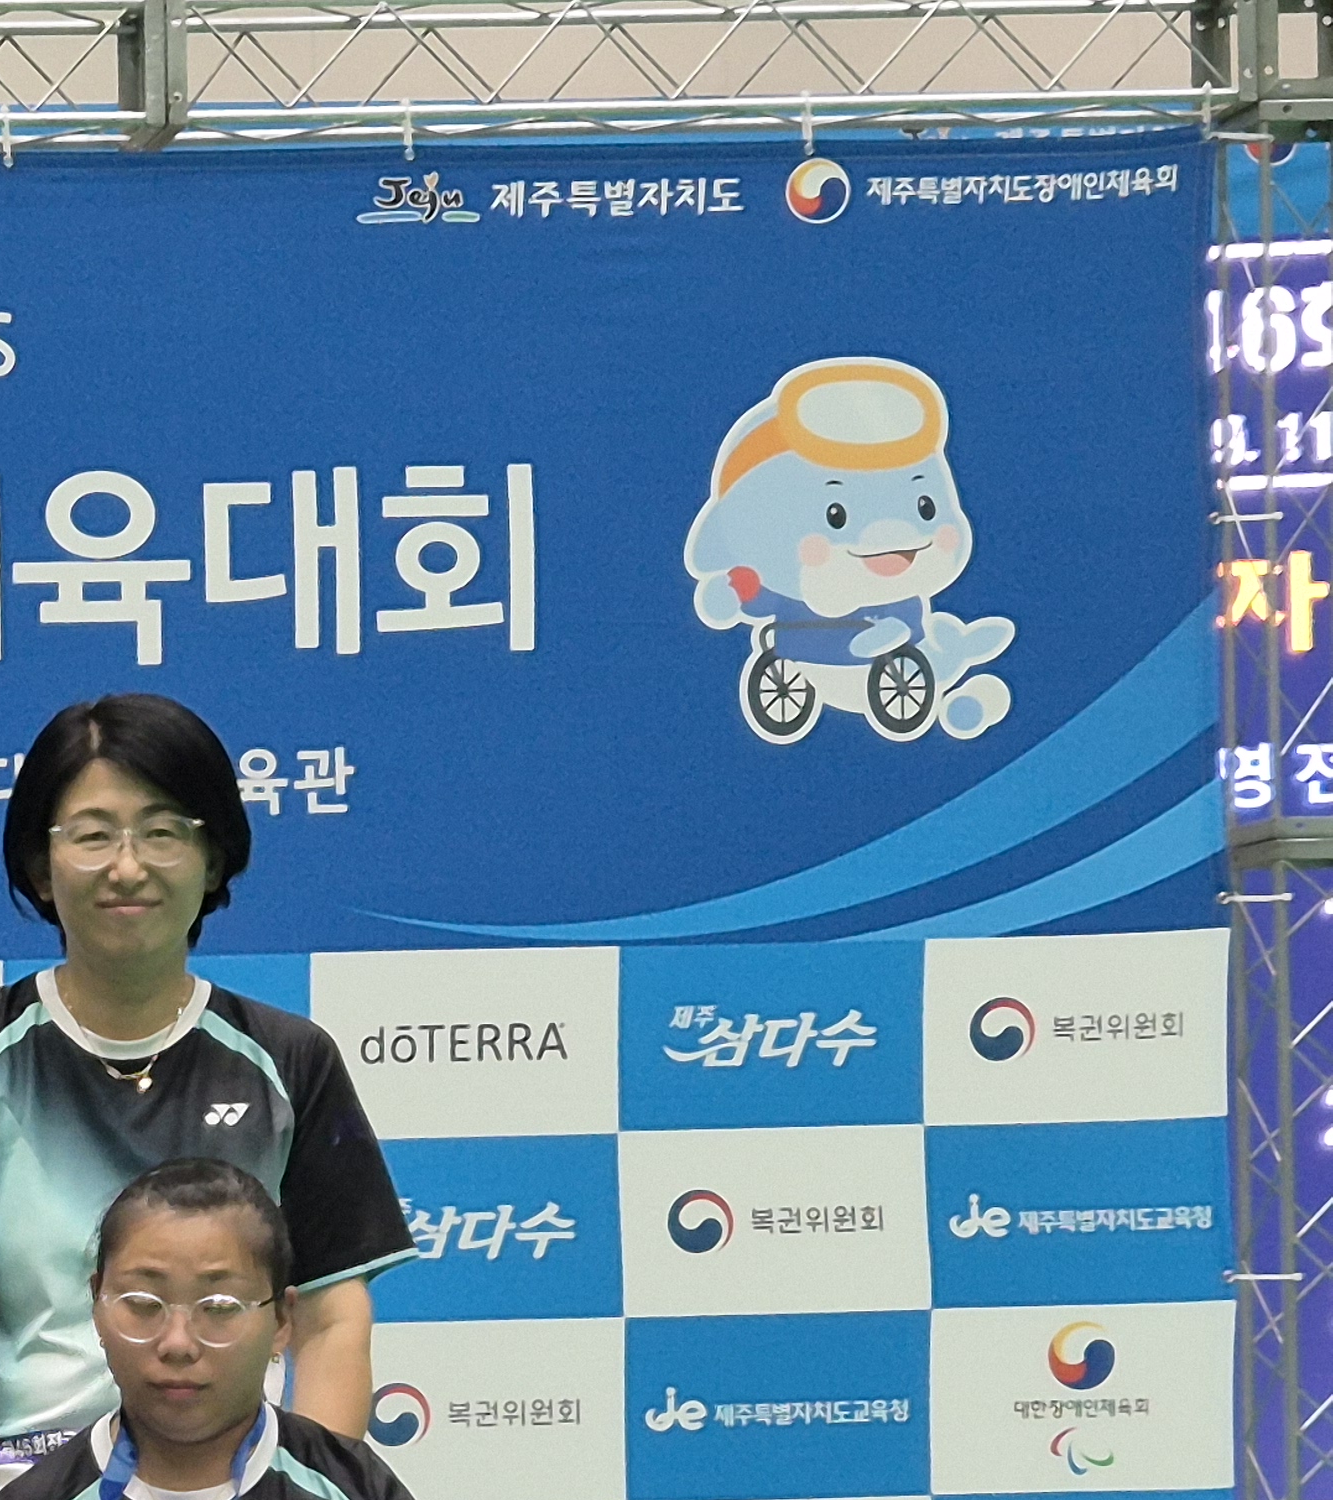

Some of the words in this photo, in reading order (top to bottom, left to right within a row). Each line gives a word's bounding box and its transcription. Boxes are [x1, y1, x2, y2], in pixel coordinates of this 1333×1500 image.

[490, 177, 745, 218] 제주특별자치도
[866, 163, 1179, 206] 제주특별자치도장애인체육회
[668, 1004, 718, 1030] 제주
[697, 1006, 879, 1070] 삼다수
[1052, 1011, 1184, 1042] 복권위원회
[360, 1022, 568, 1065] dōTERRA
[414, 1202, 577, 1260] 삼다수
[751, 1205, 884, 1234] 복권위원회
[1017, 1205, 1213, 1235] 제주특별자치도교육청
[447, 1398, 581, 1428] 복권위원회
[713, 1398, 909, 1427] 제주특별자치도교육청
[1013, 1397, 1149, 1420] 대한장애인체육회
